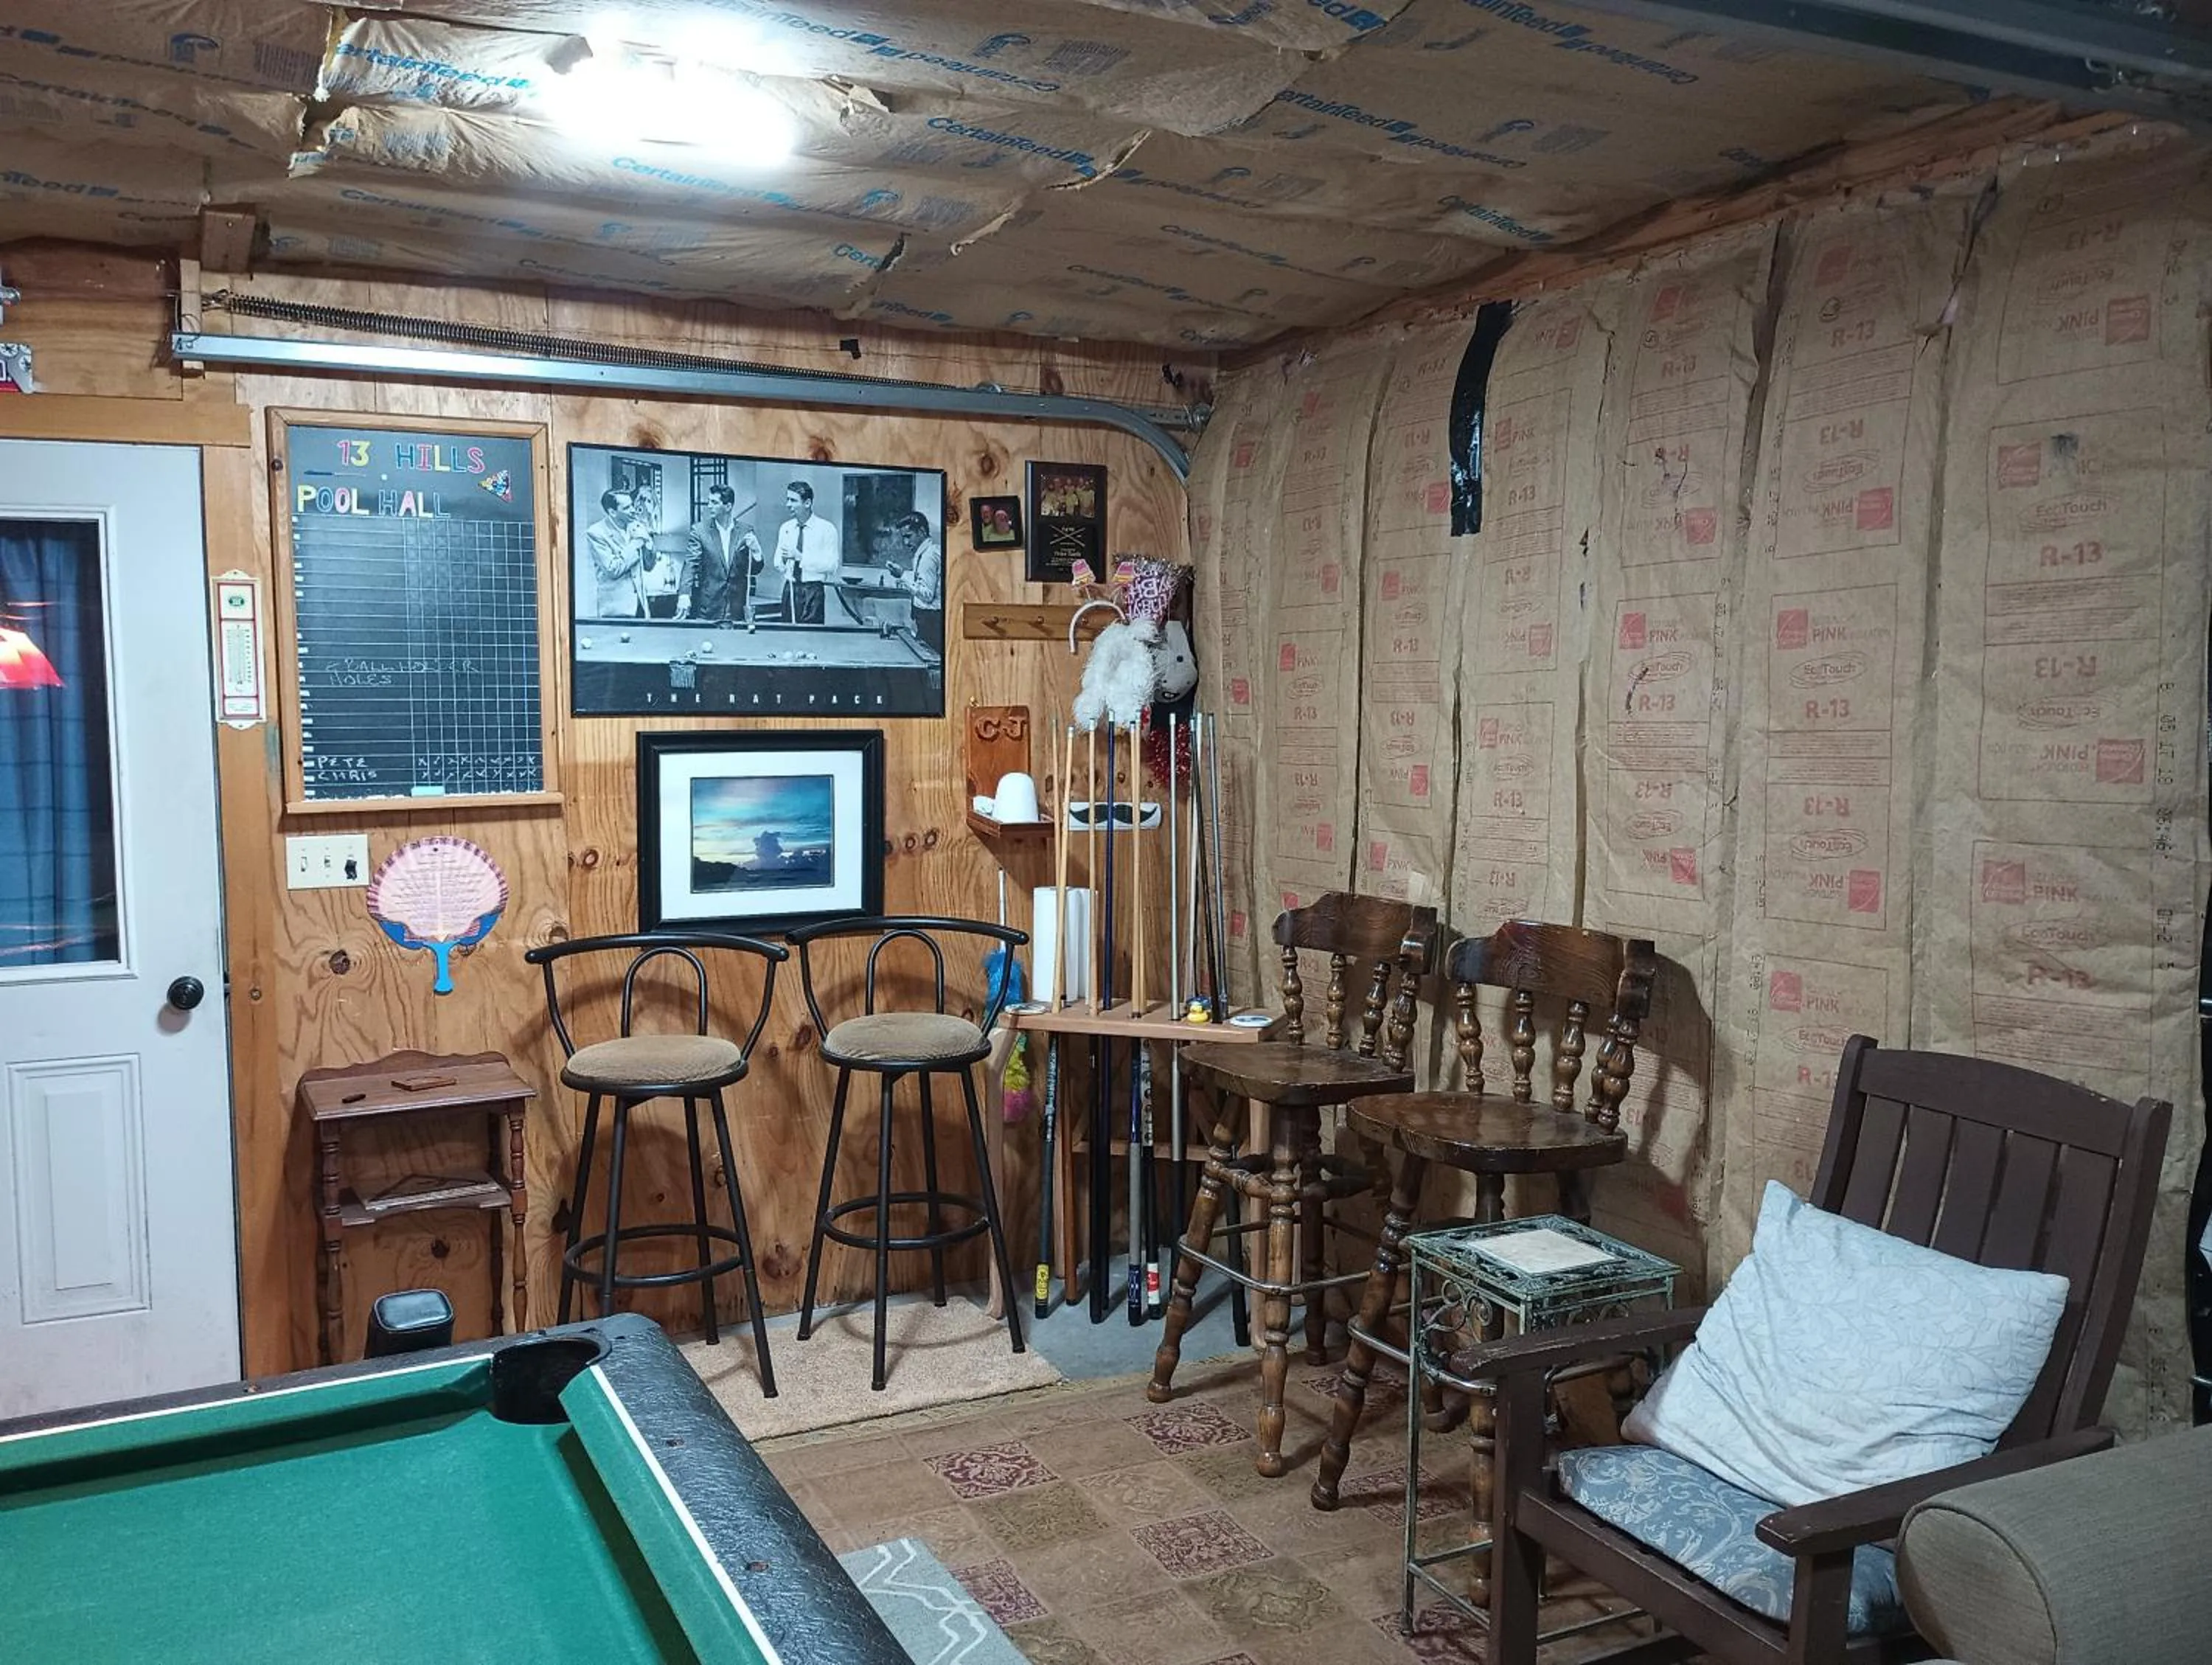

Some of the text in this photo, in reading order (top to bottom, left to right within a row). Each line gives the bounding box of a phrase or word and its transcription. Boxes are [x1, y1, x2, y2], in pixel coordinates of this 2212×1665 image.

[1276, 88, 1389, 129] ertainTeed
[2054, 308, 2099, 333] PINK
[1830, 319, 1877, 347] R-13
[1820, 418, 1864, 445] R-13
[337, 439, 487, 475] 13 HILLS
[297, 484, 451, 517] POOL HALL
[1508, 484, 1537, 507] R-13
[2039, 541, 2104, 569] R-13
[1649, 628, 1679, 644] PINK
[1812, 626, 1847, 644] PINK
[1393, 636, 1419, 654] R-13
[2034, 656, 2098, 680] R-13
[647, 692, 884, 705] THE RAT PACK
[1639, 693, 1677, 712] R-13
[1293, 706, 1318, 720] R-13
[1806, 699, 1851, 720] R-13
[2040, 743, 2090, 761] PINK
[317, 756, 368, 768] PETE
[1494, 790, 1523, 809] R-13
[1803, 795, 1851, 817] R-13
[1809, 872, 1843, 890] PINK
[2034, 886, 2079, 902] PINK
[1806, 995, 1840, 1014] PINK
